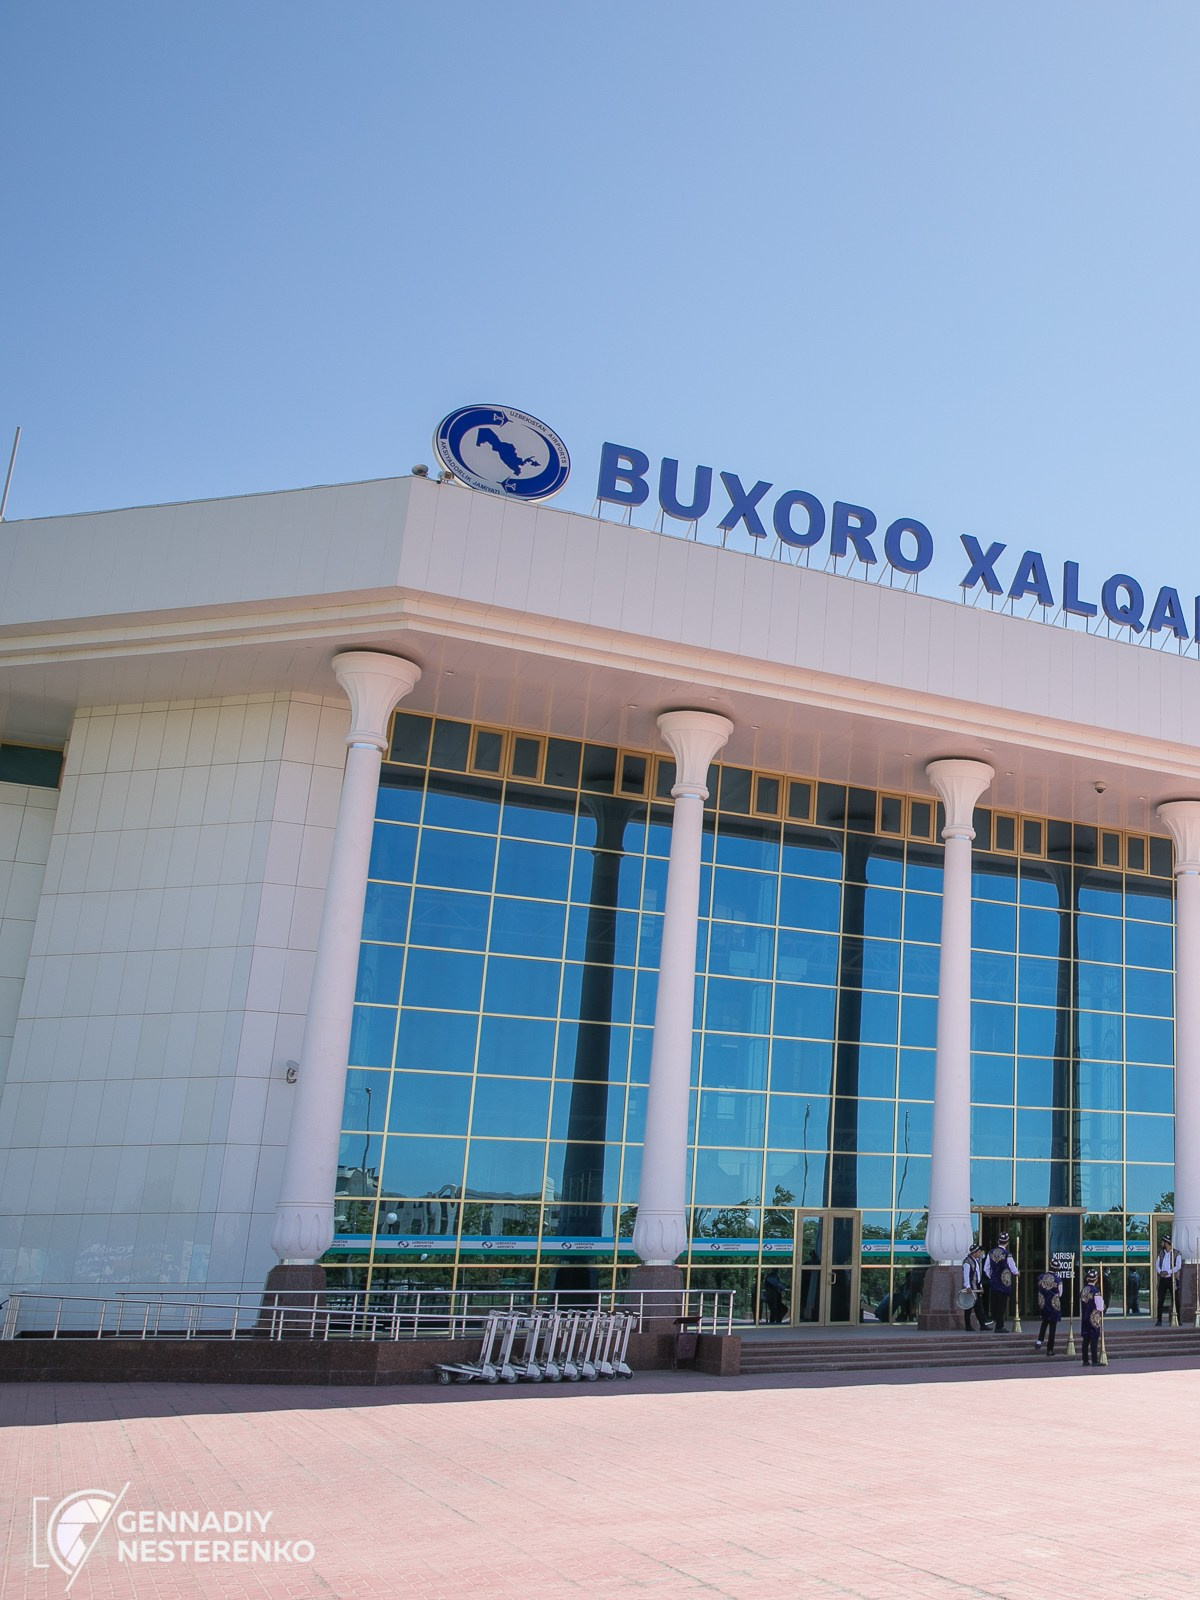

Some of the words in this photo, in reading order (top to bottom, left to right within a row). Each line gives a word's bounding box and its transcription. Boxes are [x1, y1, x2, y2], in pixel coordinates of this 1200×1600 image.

[509, 411, 546, 432] UZBEKISTAN
[547, 433, 567, 464] AIRPORTS
[440, 440, 472, 482] AKSIYADORLIK
[472, 481, 500, 495] JAMIYATI
[597, 442, 933, 573] BUXORO
[1053, 1252, 1075, 1260] KIRISH
[1056, 1260, 1073, 1270] ХОД
